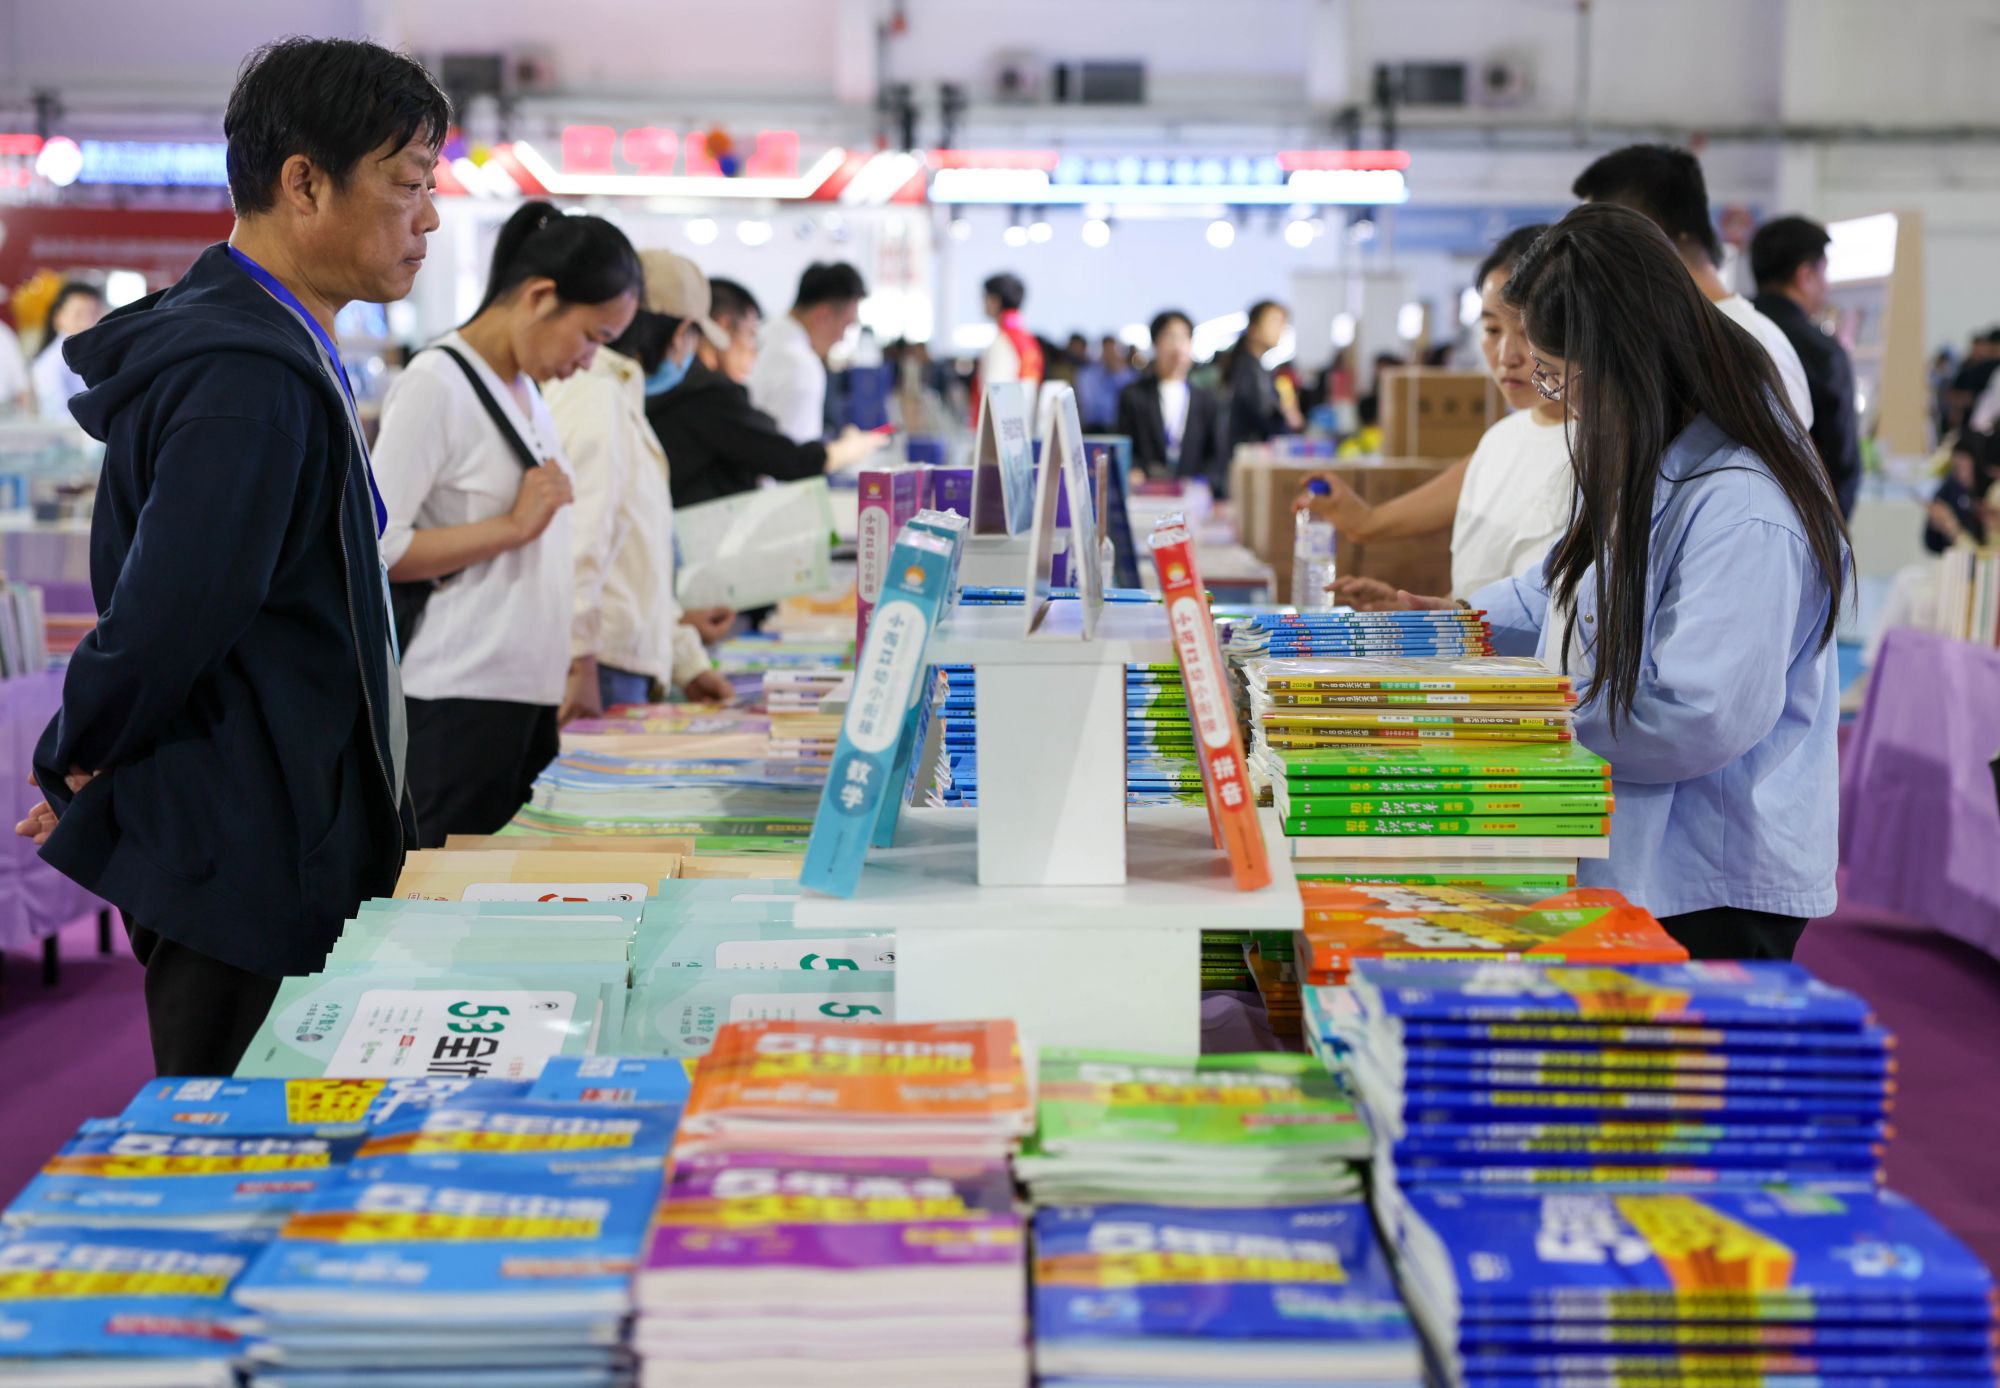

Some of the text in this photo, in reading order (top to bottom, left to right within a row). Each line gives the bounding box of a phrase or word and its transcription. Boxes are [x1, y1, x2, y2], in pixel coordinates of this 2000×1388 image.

[840, 758, 873, 809] 数学
[1211, 755, 1243, 807] 拼音
[1379, 801, 1438, 815] 知识清单
[1374, 819, 1434, 833] 知识清单
